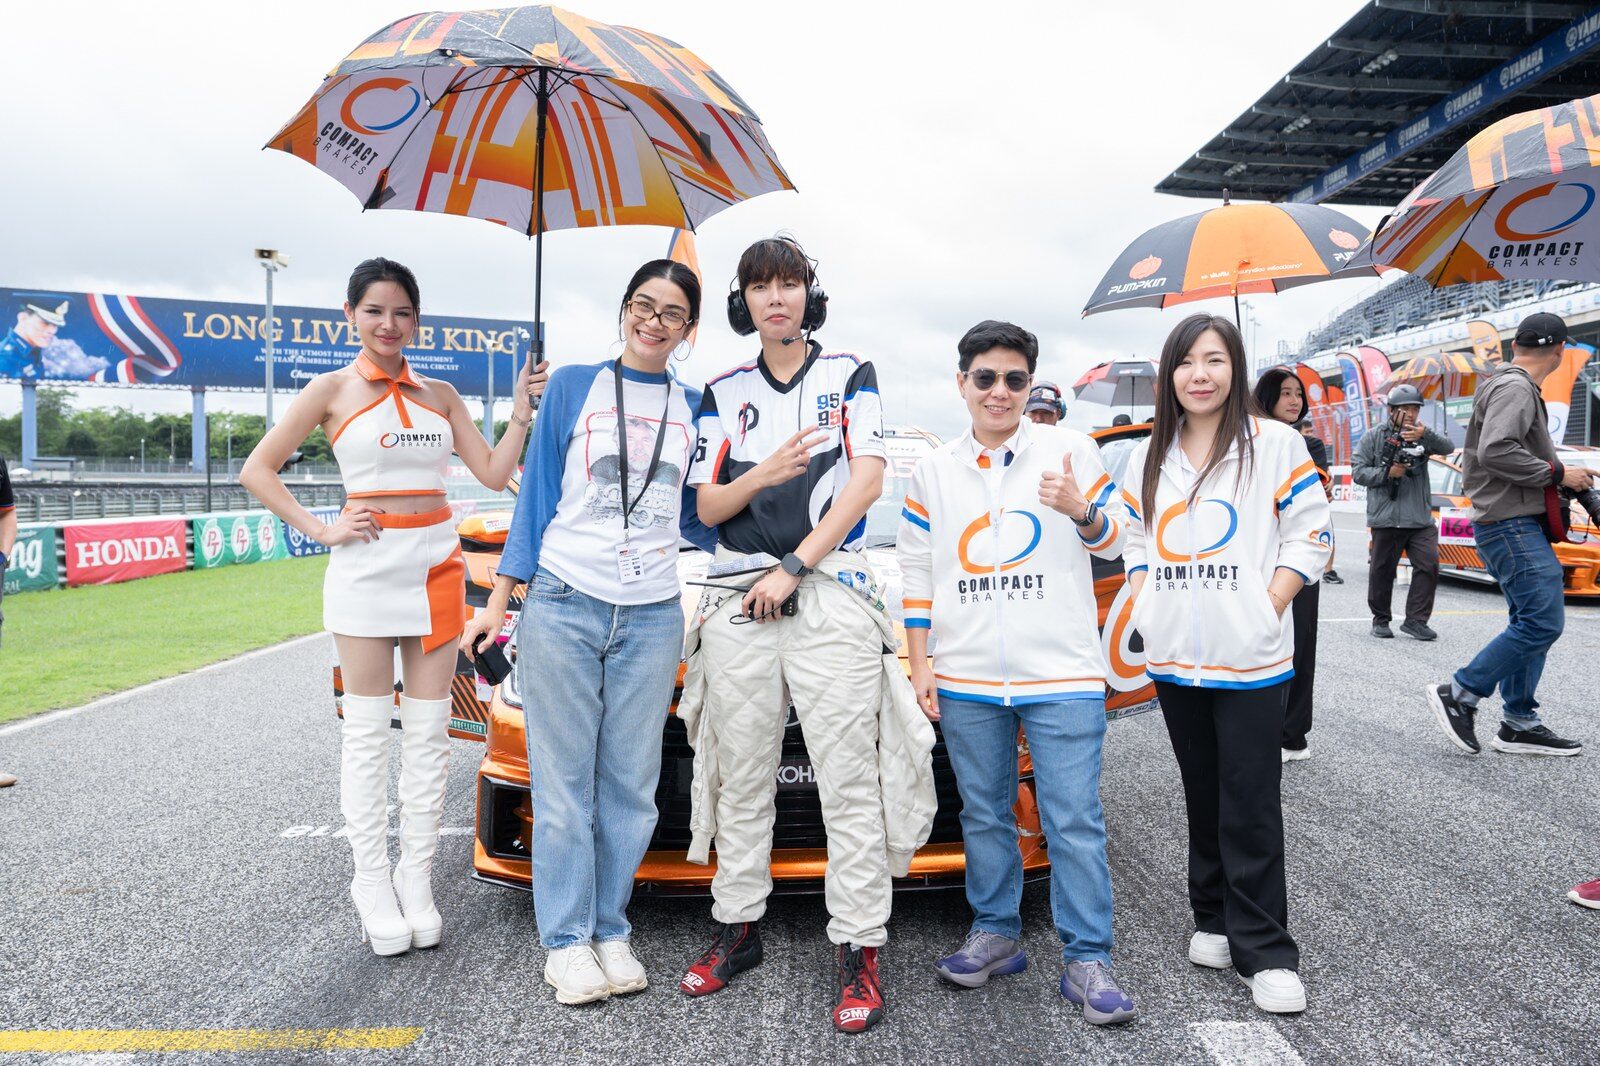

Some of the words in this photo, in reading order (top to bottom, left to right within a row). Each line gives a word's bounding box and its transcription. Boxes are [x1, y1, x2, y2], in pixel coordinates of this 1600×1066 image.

[1509, 47, 1543, 81] YAMAHA
[1452, 83, 1482, 112] YAMAHA
[320, 121, 379, 166] COMPACT
[312, 136, 367, 175] BRAKES
[1488, 242, 1584, 259] COMPACT
[1486, 257, 1578, 269] BRAKES
[1107, 278, 1167, 296] PUMPKIN
[183, 312, 283, 342] LONG
[442, 327, 519, 354] KING
[300, 349, 332, 357] UTMOST
[430, 363, 459, 371] CIRCUIT
[400, 433, 442, 442] COMPACT
[75, 536, 181, 568] HONDA
[294, 545, 329, 556] RACI
[1155, 580, 1238, 592] BRAKES
[960, 590, 1044, 604] BRAKES
